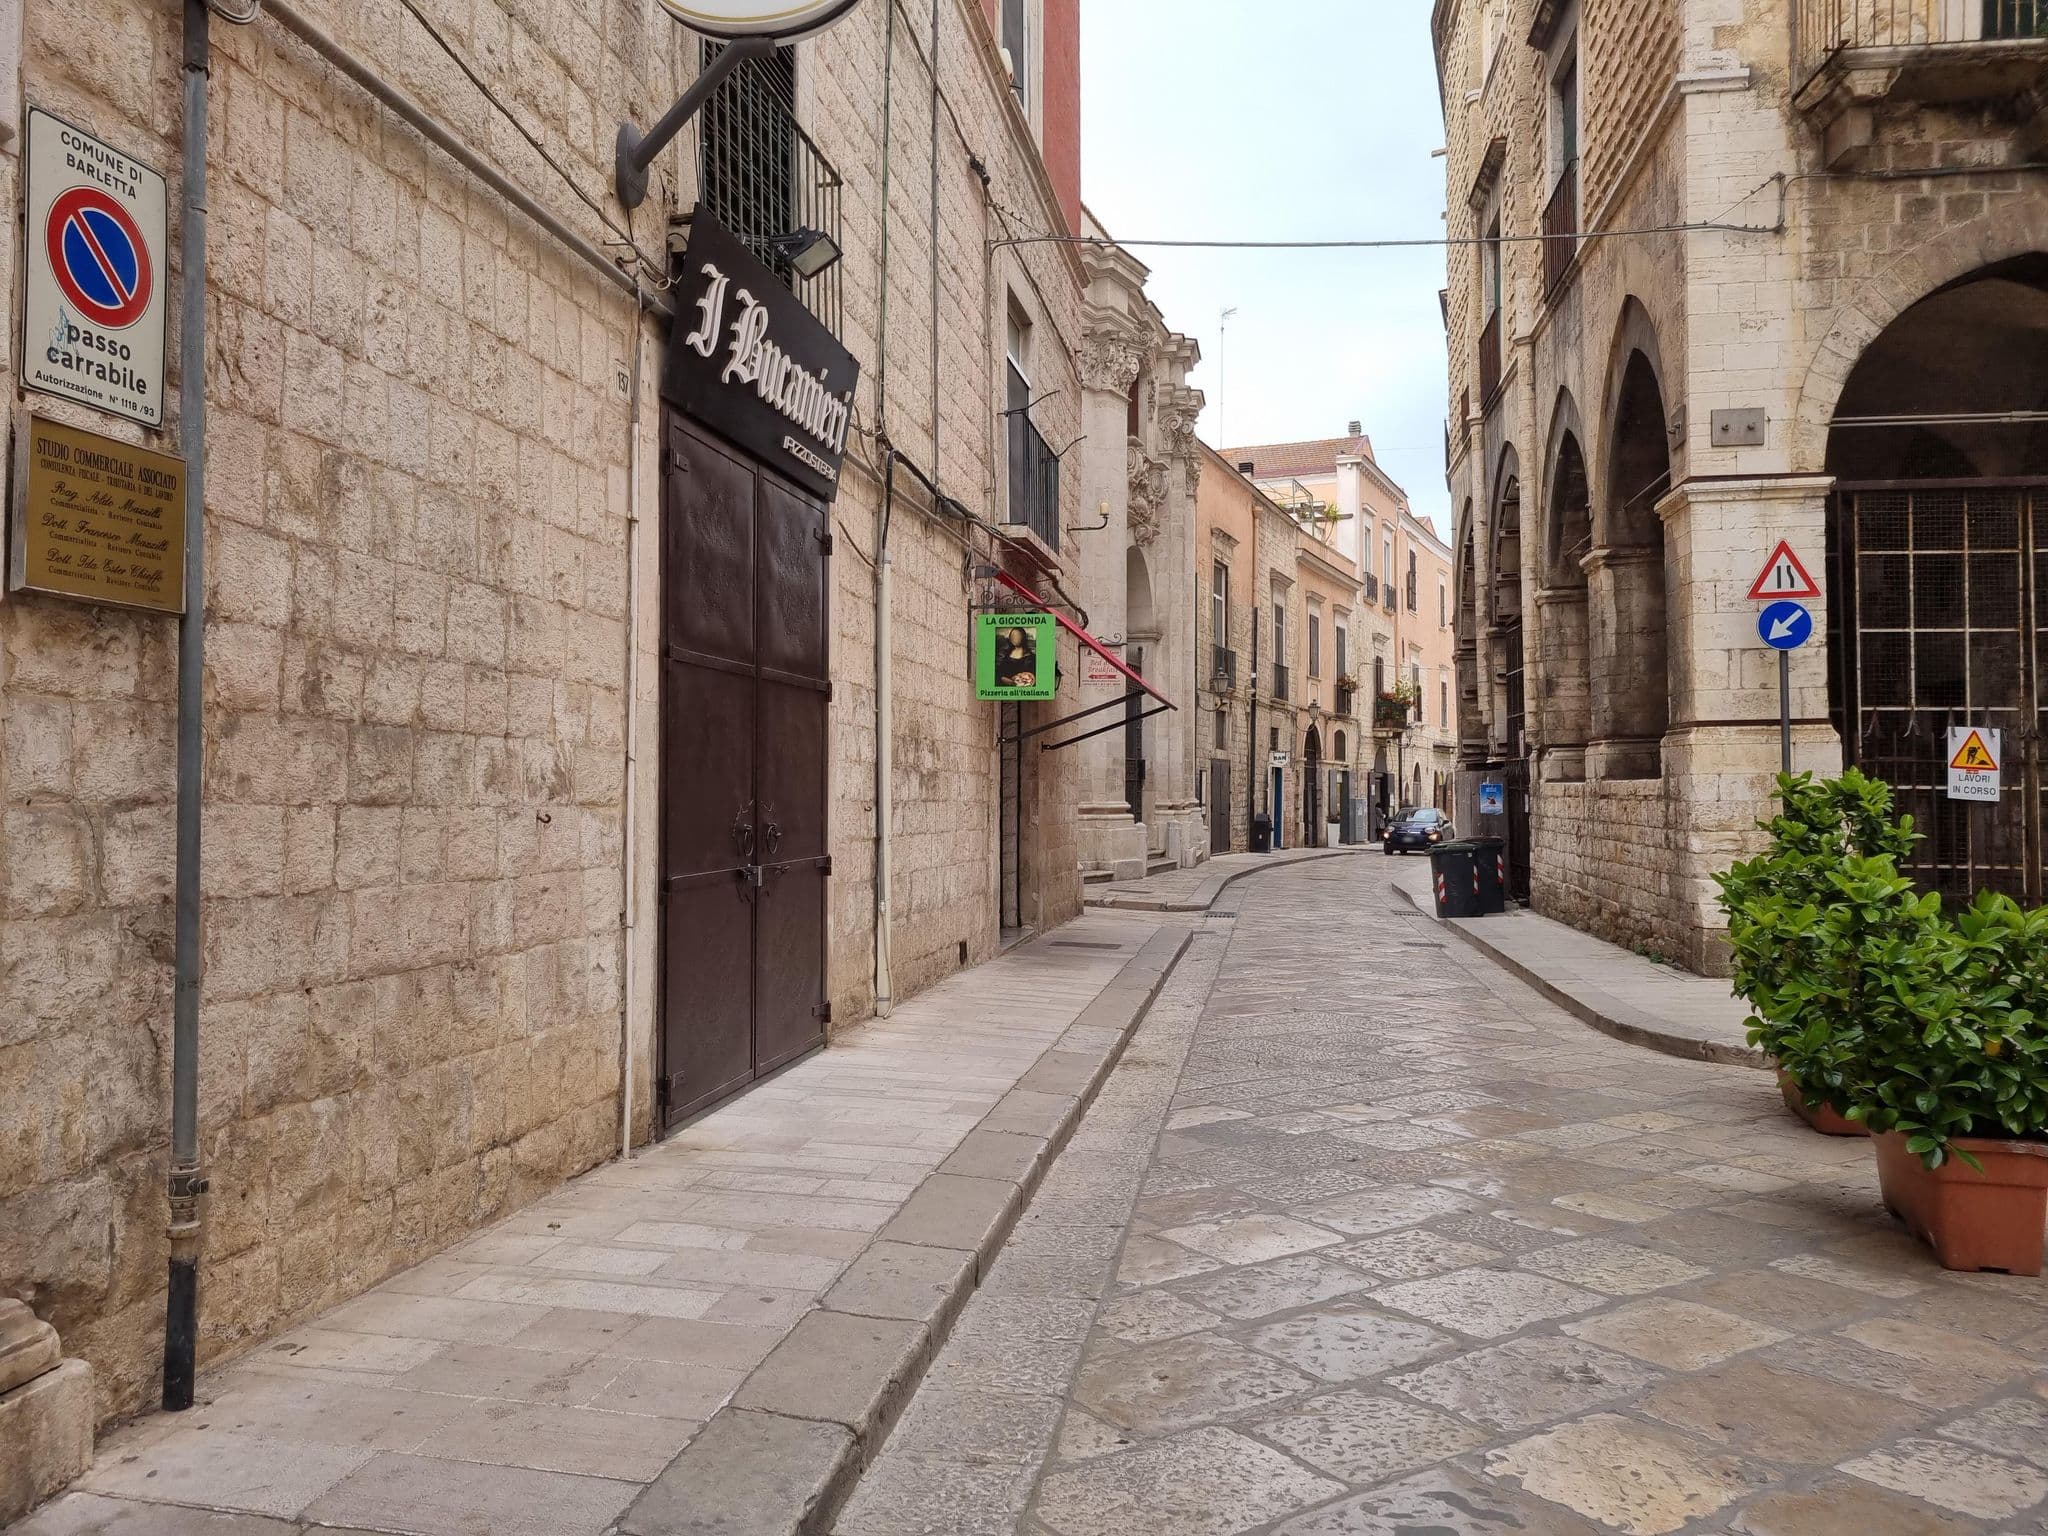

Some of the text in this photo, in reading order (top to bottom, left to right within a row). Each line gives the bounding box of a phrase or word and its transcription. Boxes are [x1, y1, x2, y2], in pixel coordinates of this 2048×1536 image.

[61, 131, 142, 185] COMUNE DI
[66, 152, 137, 200] BARLETTA
[67, 323, 131, 361] passo
[35, 369, 103, 400] Autorizzazione
[121, 397, 138, 411] 1118
[139, 404, 155, 418] /93
[46, 346, 147, 395] carrabile
[721, 288, 852, 455] Bucanieri
[37, 437, 177, 491] STUDIO COMMERCIALE ASSOCIATO
[985, 616, 1047, 625] LA GIOCONDA
[980, 689, 1008, 697] Pizzeria
[1952, 785, 1997, 796] IN CORSO
[1958, 774, 1991, 783] LAVORI
